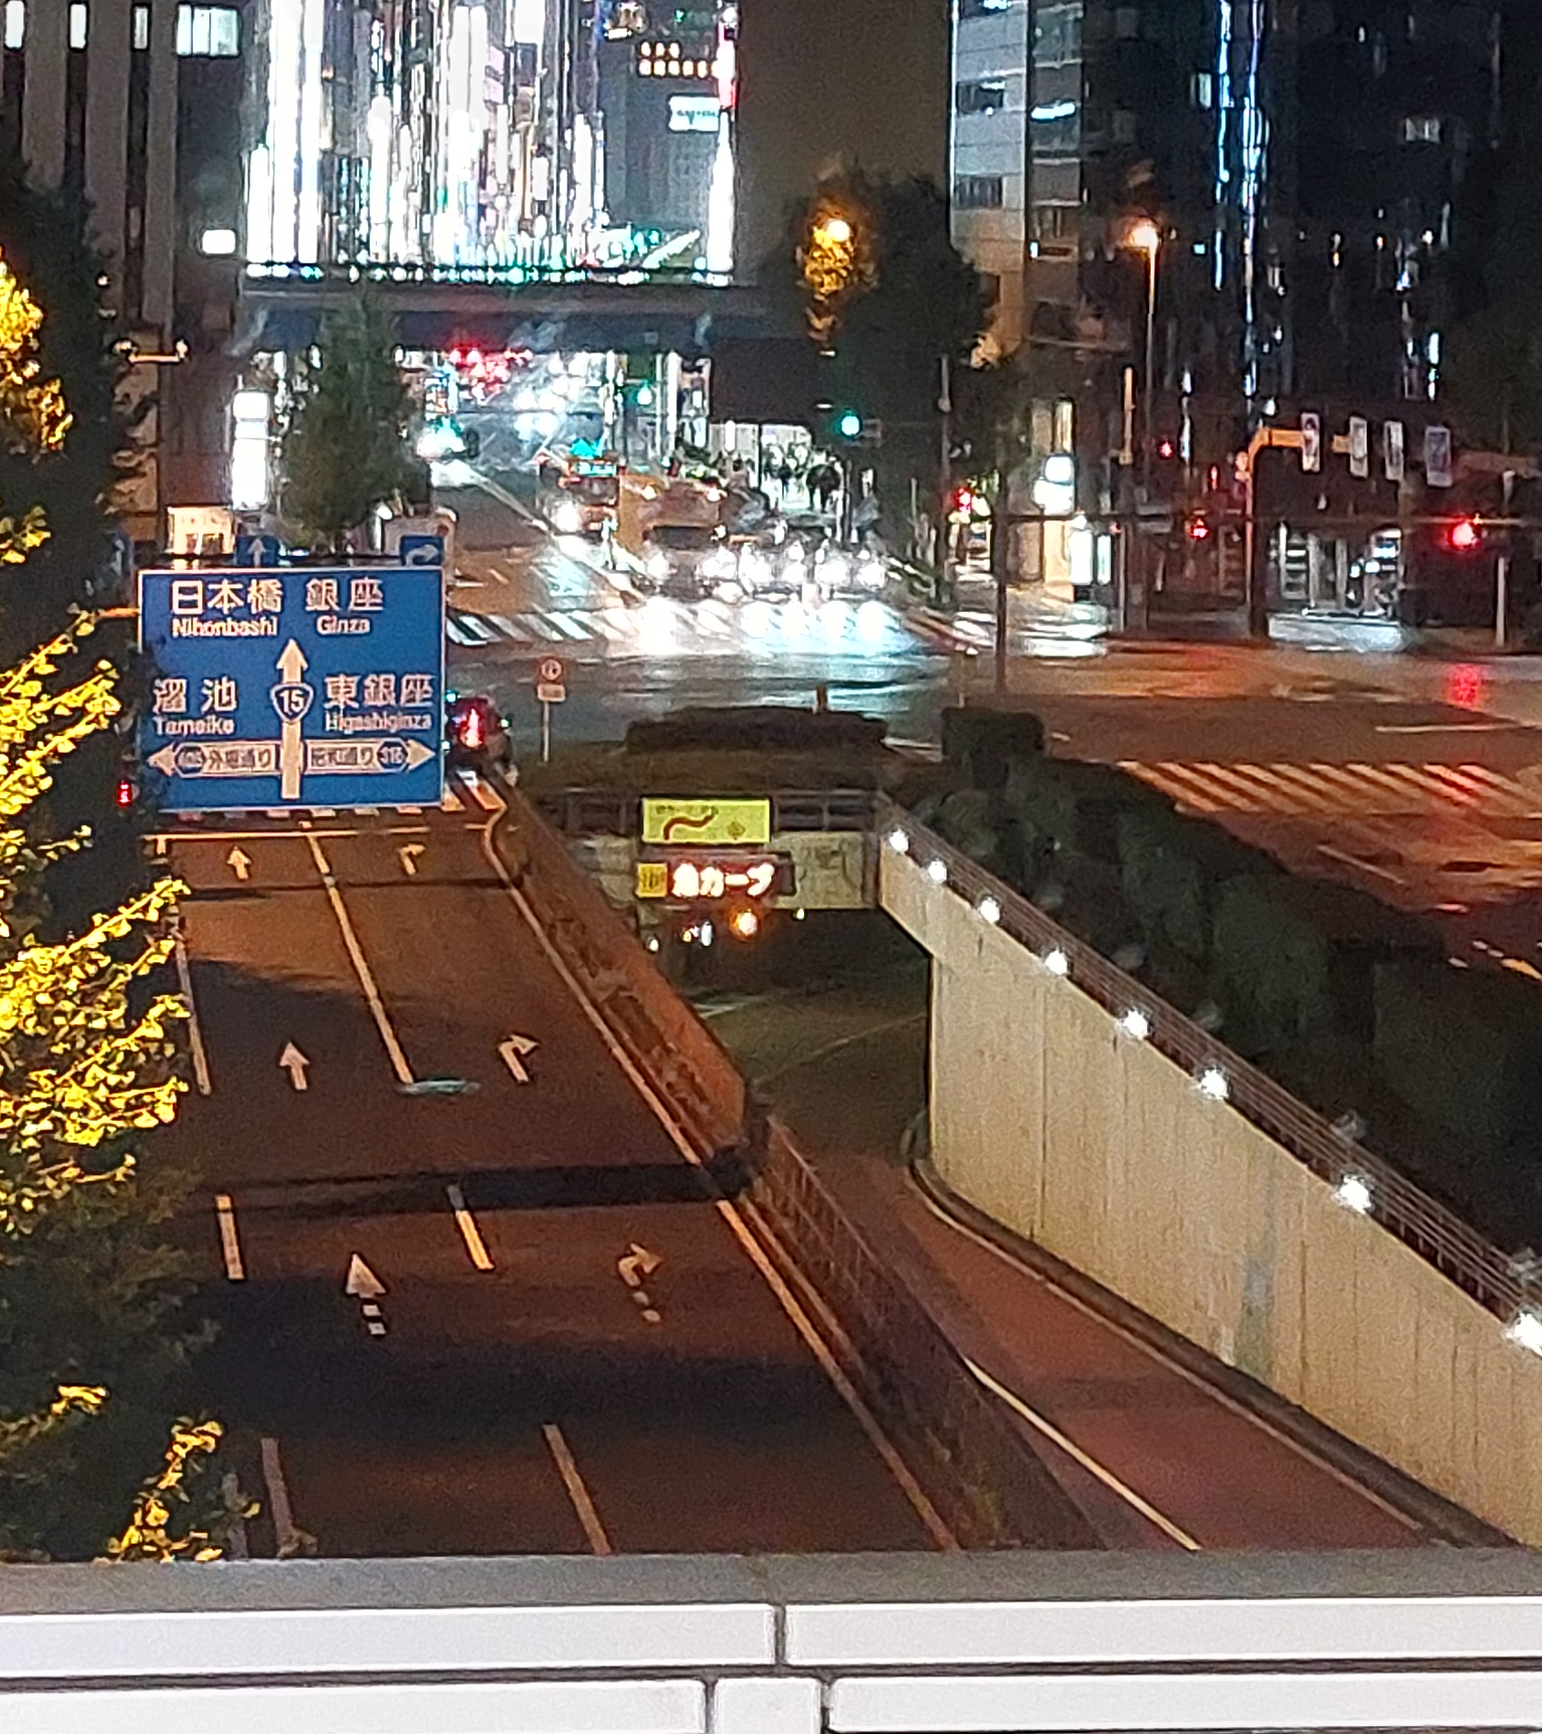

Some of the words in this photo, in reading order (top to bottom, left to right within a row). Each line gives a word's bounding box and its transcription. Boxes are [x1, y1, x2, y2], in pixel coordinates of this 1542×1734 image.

[171, 579, 282, 614] 日本橋
[305, 577, 385, 612] 銀座
[172, 618, 278, 637] Nihonbashi
[316, 615, 371, 635] Ginza
[152, 675, 238, 714] 溜池
[280, 689, 304, 710] 15
[323, 673, 436, 708] 東銀座
[325, 711, 432, 734] Higashiginza
